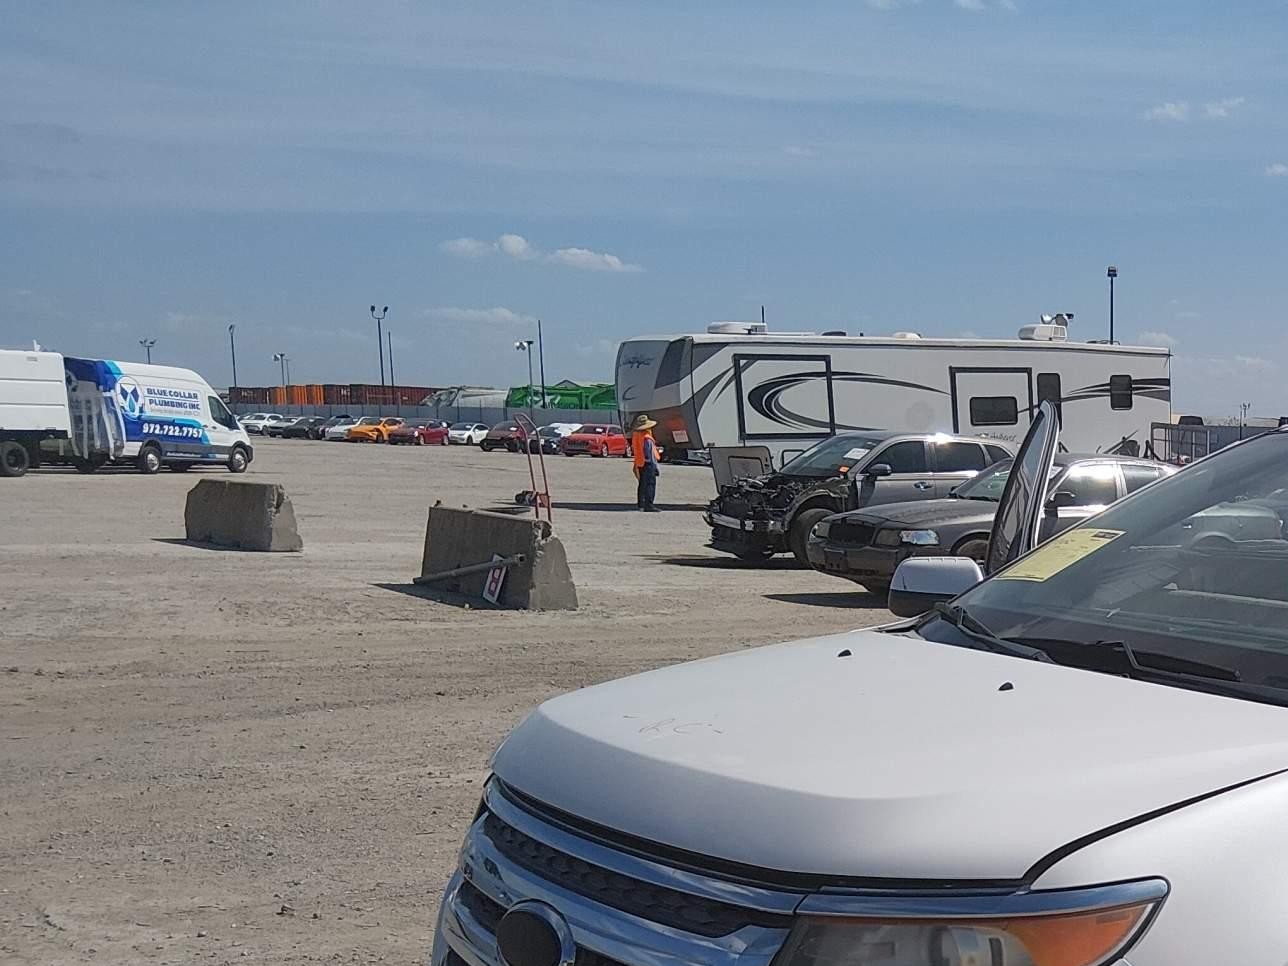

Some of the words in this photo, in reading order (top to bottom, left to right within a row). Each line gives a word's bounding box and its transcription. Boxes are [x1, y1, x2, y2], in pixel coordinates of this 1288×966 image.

[147, 387, 168, 397] BLUE
[168, 390, 198, 400] COLLAR
[149, 398, 188, 409] PLUMBING
[142, 423, 203, 438] 972.722.7757
